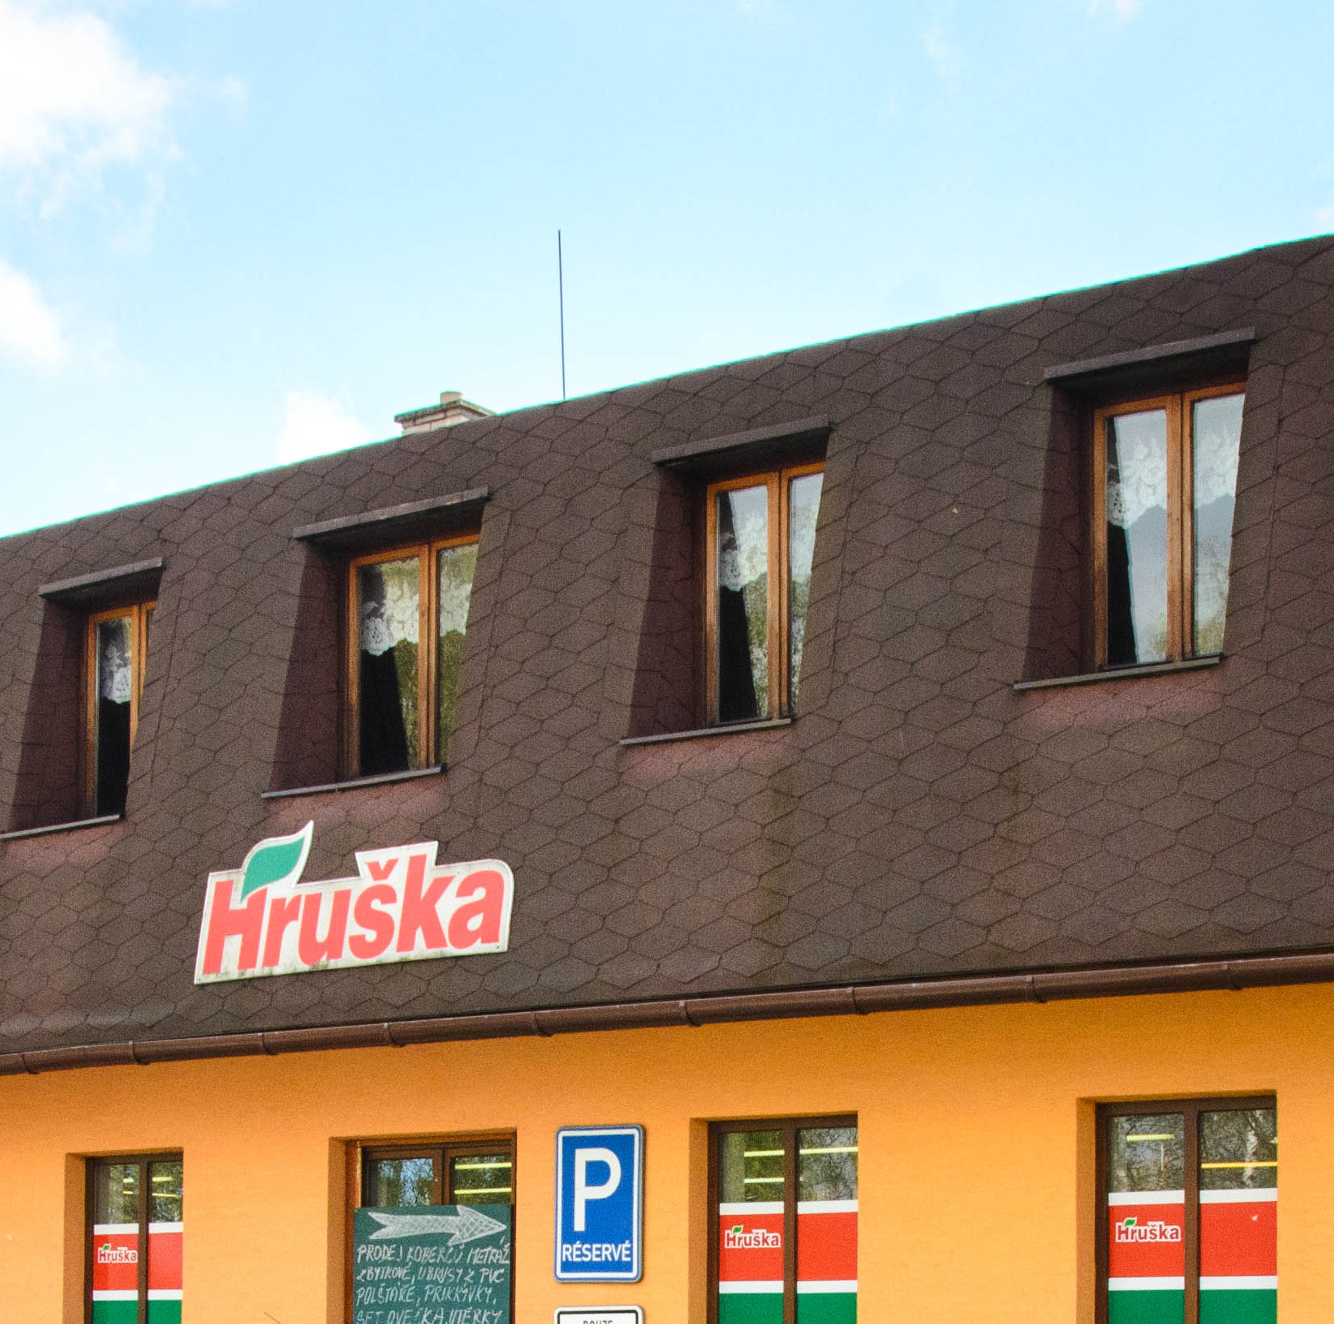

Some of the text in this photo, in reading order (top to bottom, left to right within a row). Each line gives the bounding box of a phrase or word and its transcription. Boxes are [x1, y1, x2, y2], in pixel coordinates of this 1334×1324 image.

[202, 854, 506, 969] Hruška
[574, 1147, 622, 1232] P
[726, 1230, 779, 1247] Hruška
[1117, 1223, 1179, 1241] Hruška
[99, 1248, 137, 1262] Hruška
[357, 1244, 403, 1264] PRODEJ
[562, 1241, 632, 1262] RÉSERVÉ
[480, 1267, 505, 1283] PVC
